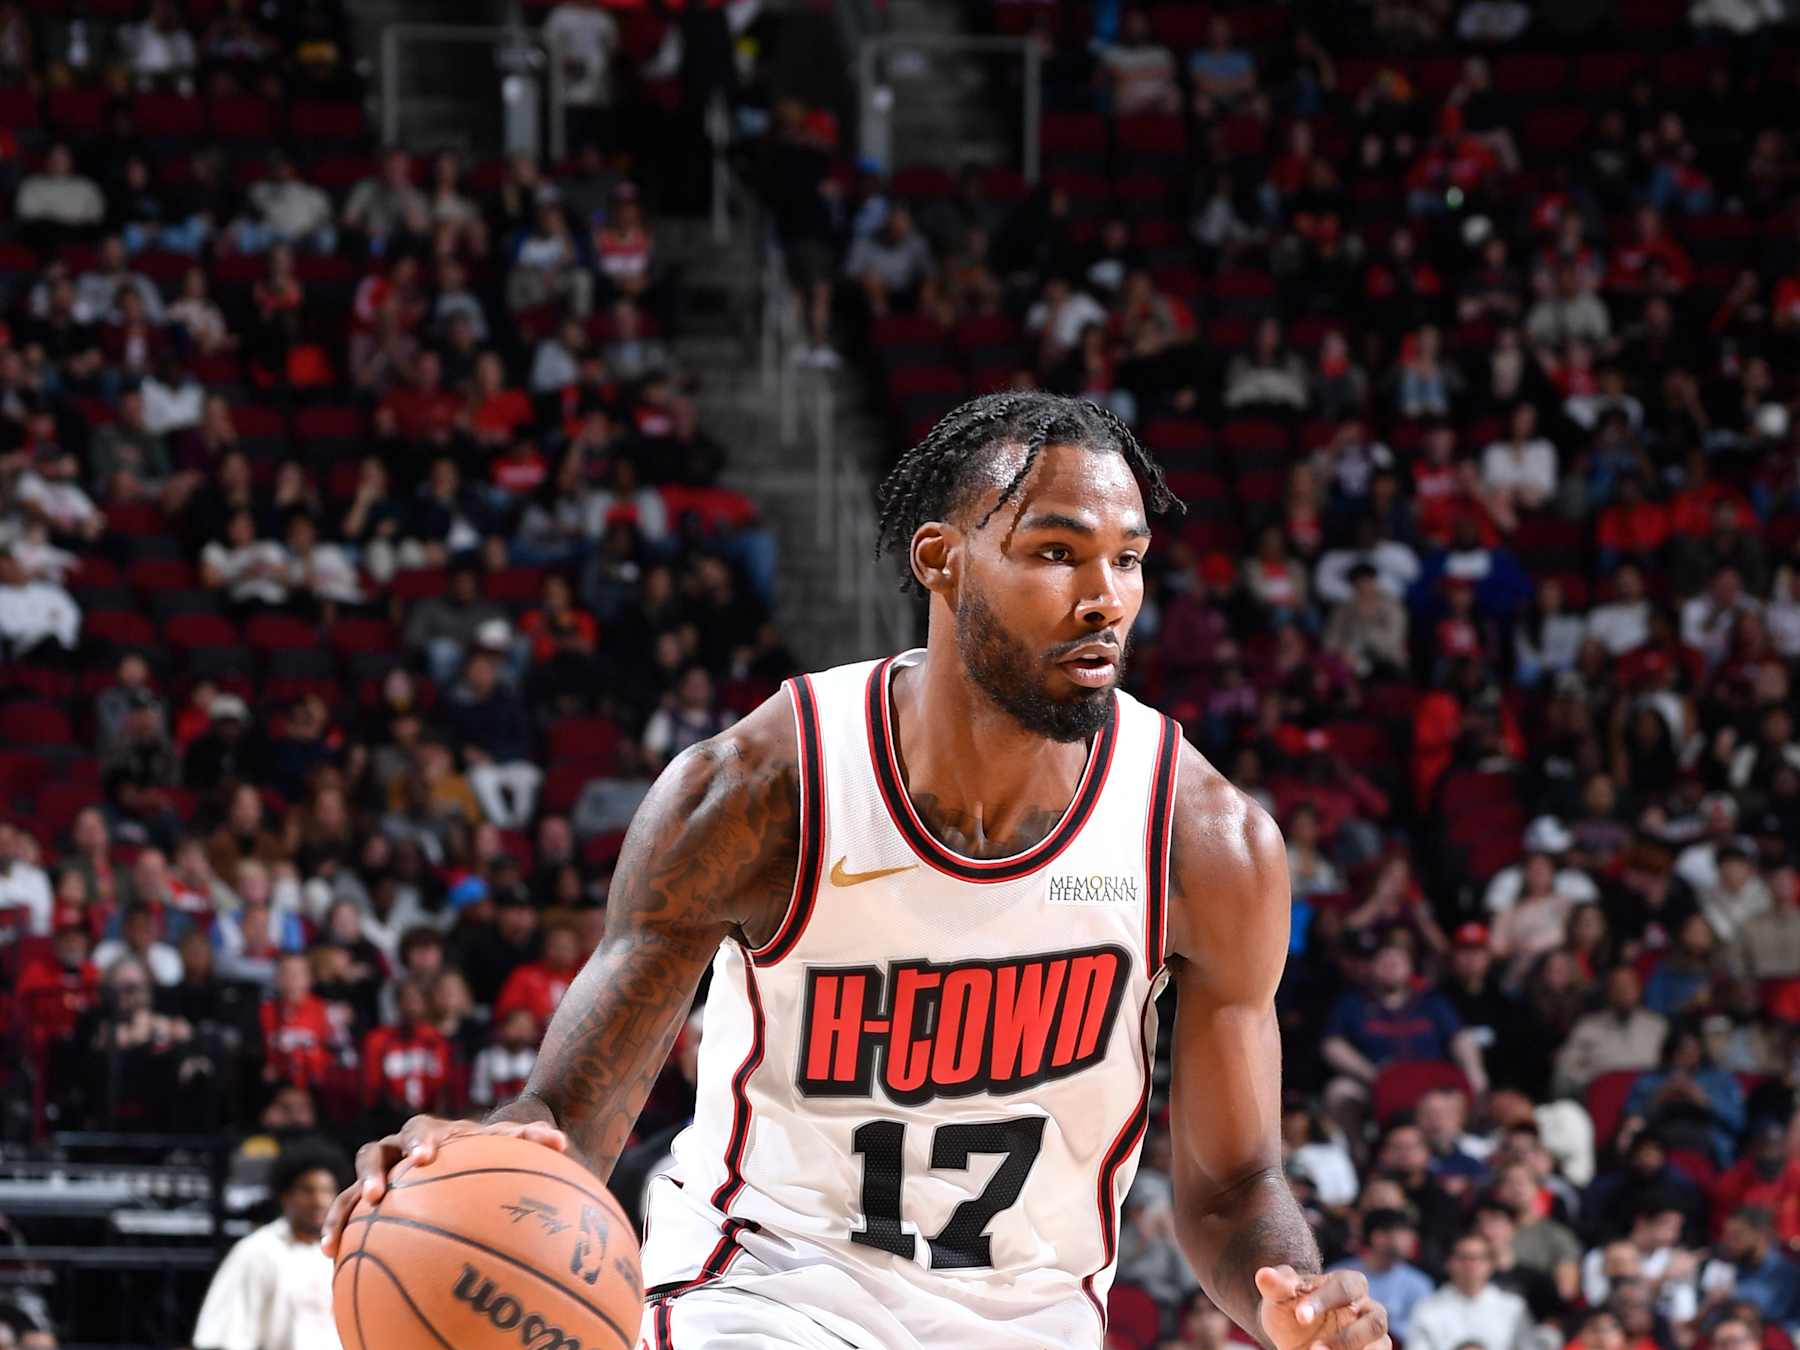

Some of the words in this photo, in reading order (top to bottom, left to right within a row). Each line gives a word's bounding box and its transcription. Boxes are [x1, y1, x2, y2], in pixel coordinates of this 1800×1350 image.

[1049, 875, 1137, 889] MEMORIAL
[1049, 888, 1137, 901] HERMANN
[851, 1118, 1046, 1269] 17
